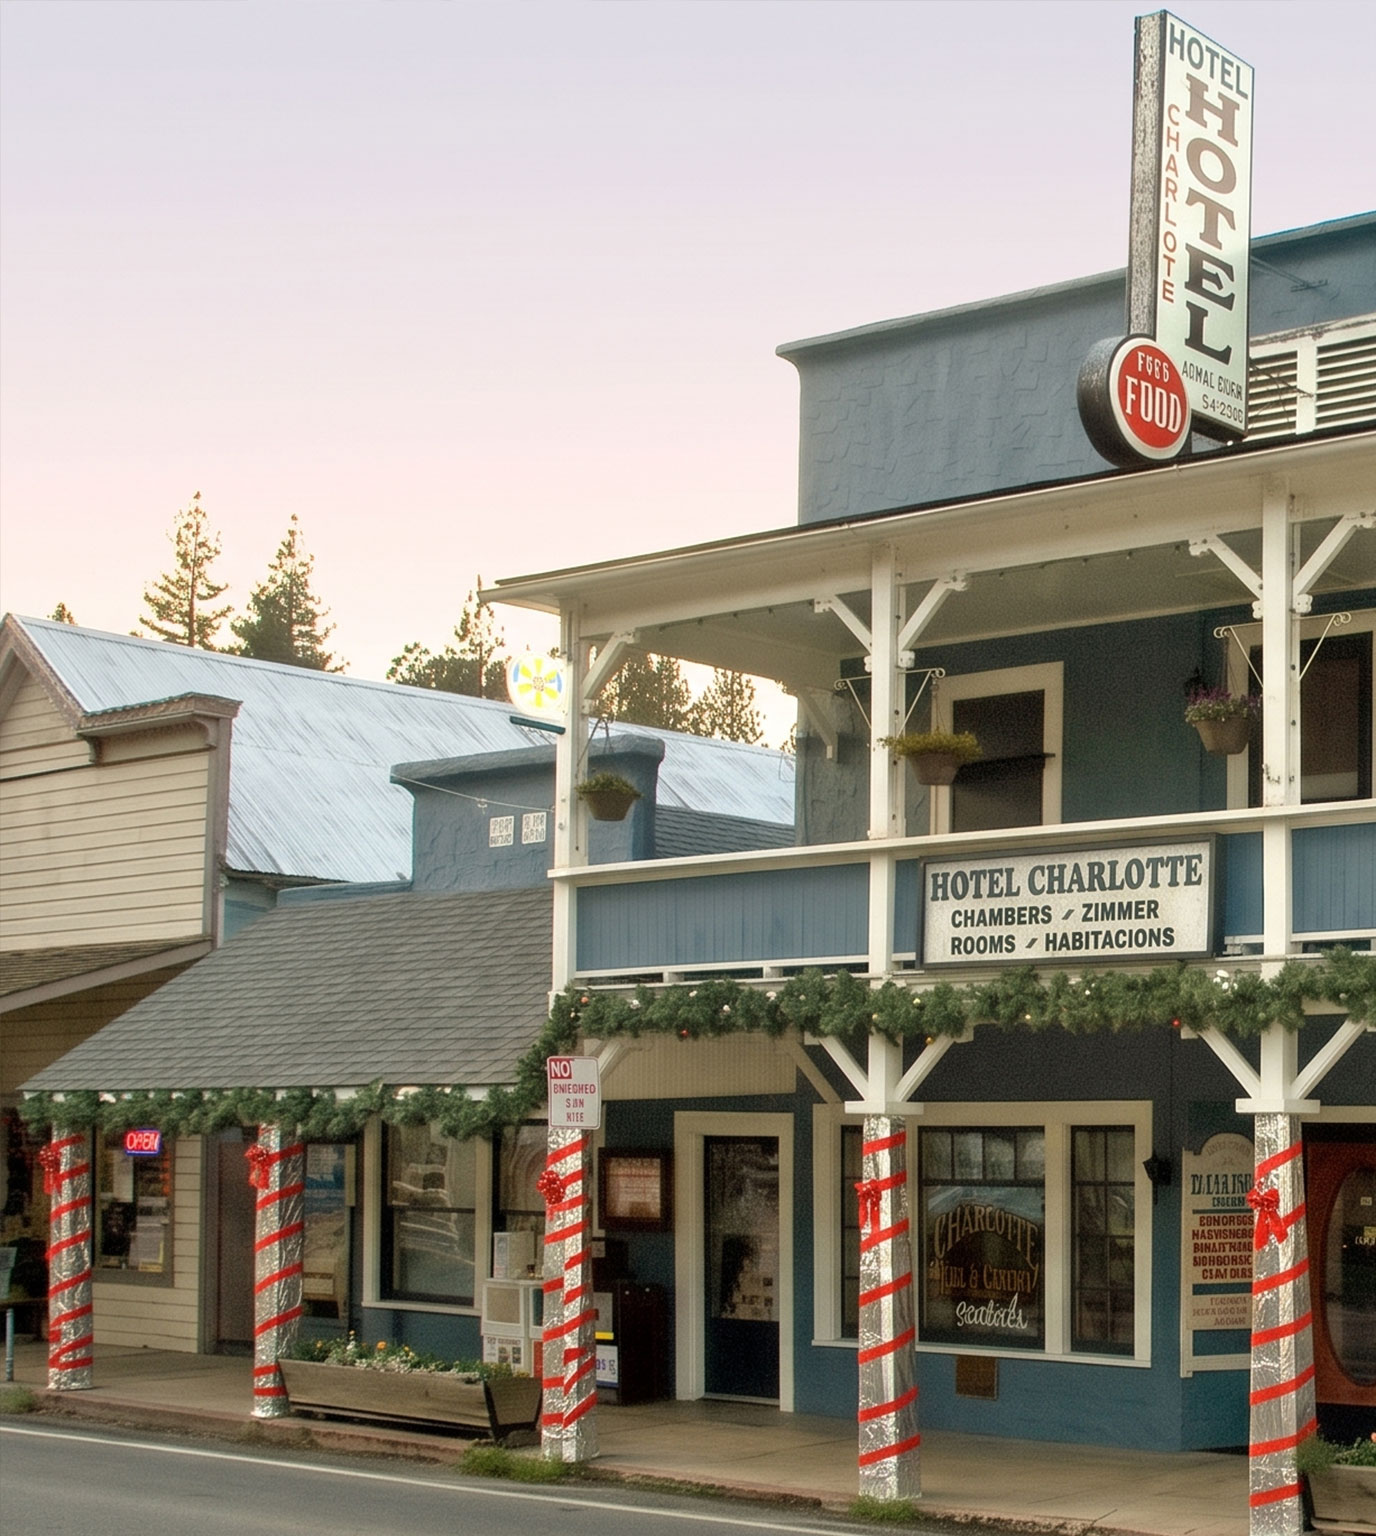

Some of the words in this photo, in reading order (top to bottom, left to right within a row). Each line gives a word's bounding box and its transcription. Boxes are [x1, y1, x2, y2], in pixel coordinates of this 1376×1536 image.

[1169, 22, 1249, 100] HOTEL
[1163, 103, 1180, 304] CHARLOTE
[1185, 72, 1240, 365] HOTEL
[1125, 374, 1182, 434] FOOD
[930, 867, 1020, 902] HOTEL
[1028, 853, 1203, 896] CHARLOTTE
[951, 904, 1052, 929] CHAMBERS
[1081, 899, 1159, 923] ZIMMER
[951, 934, 1016, 955] ROOMS
[1045, 927, 1175, 952] HABITACIONS
[551, 1060, 570, 1078] NO
[126, 1132, 160, 1150] OPEN
